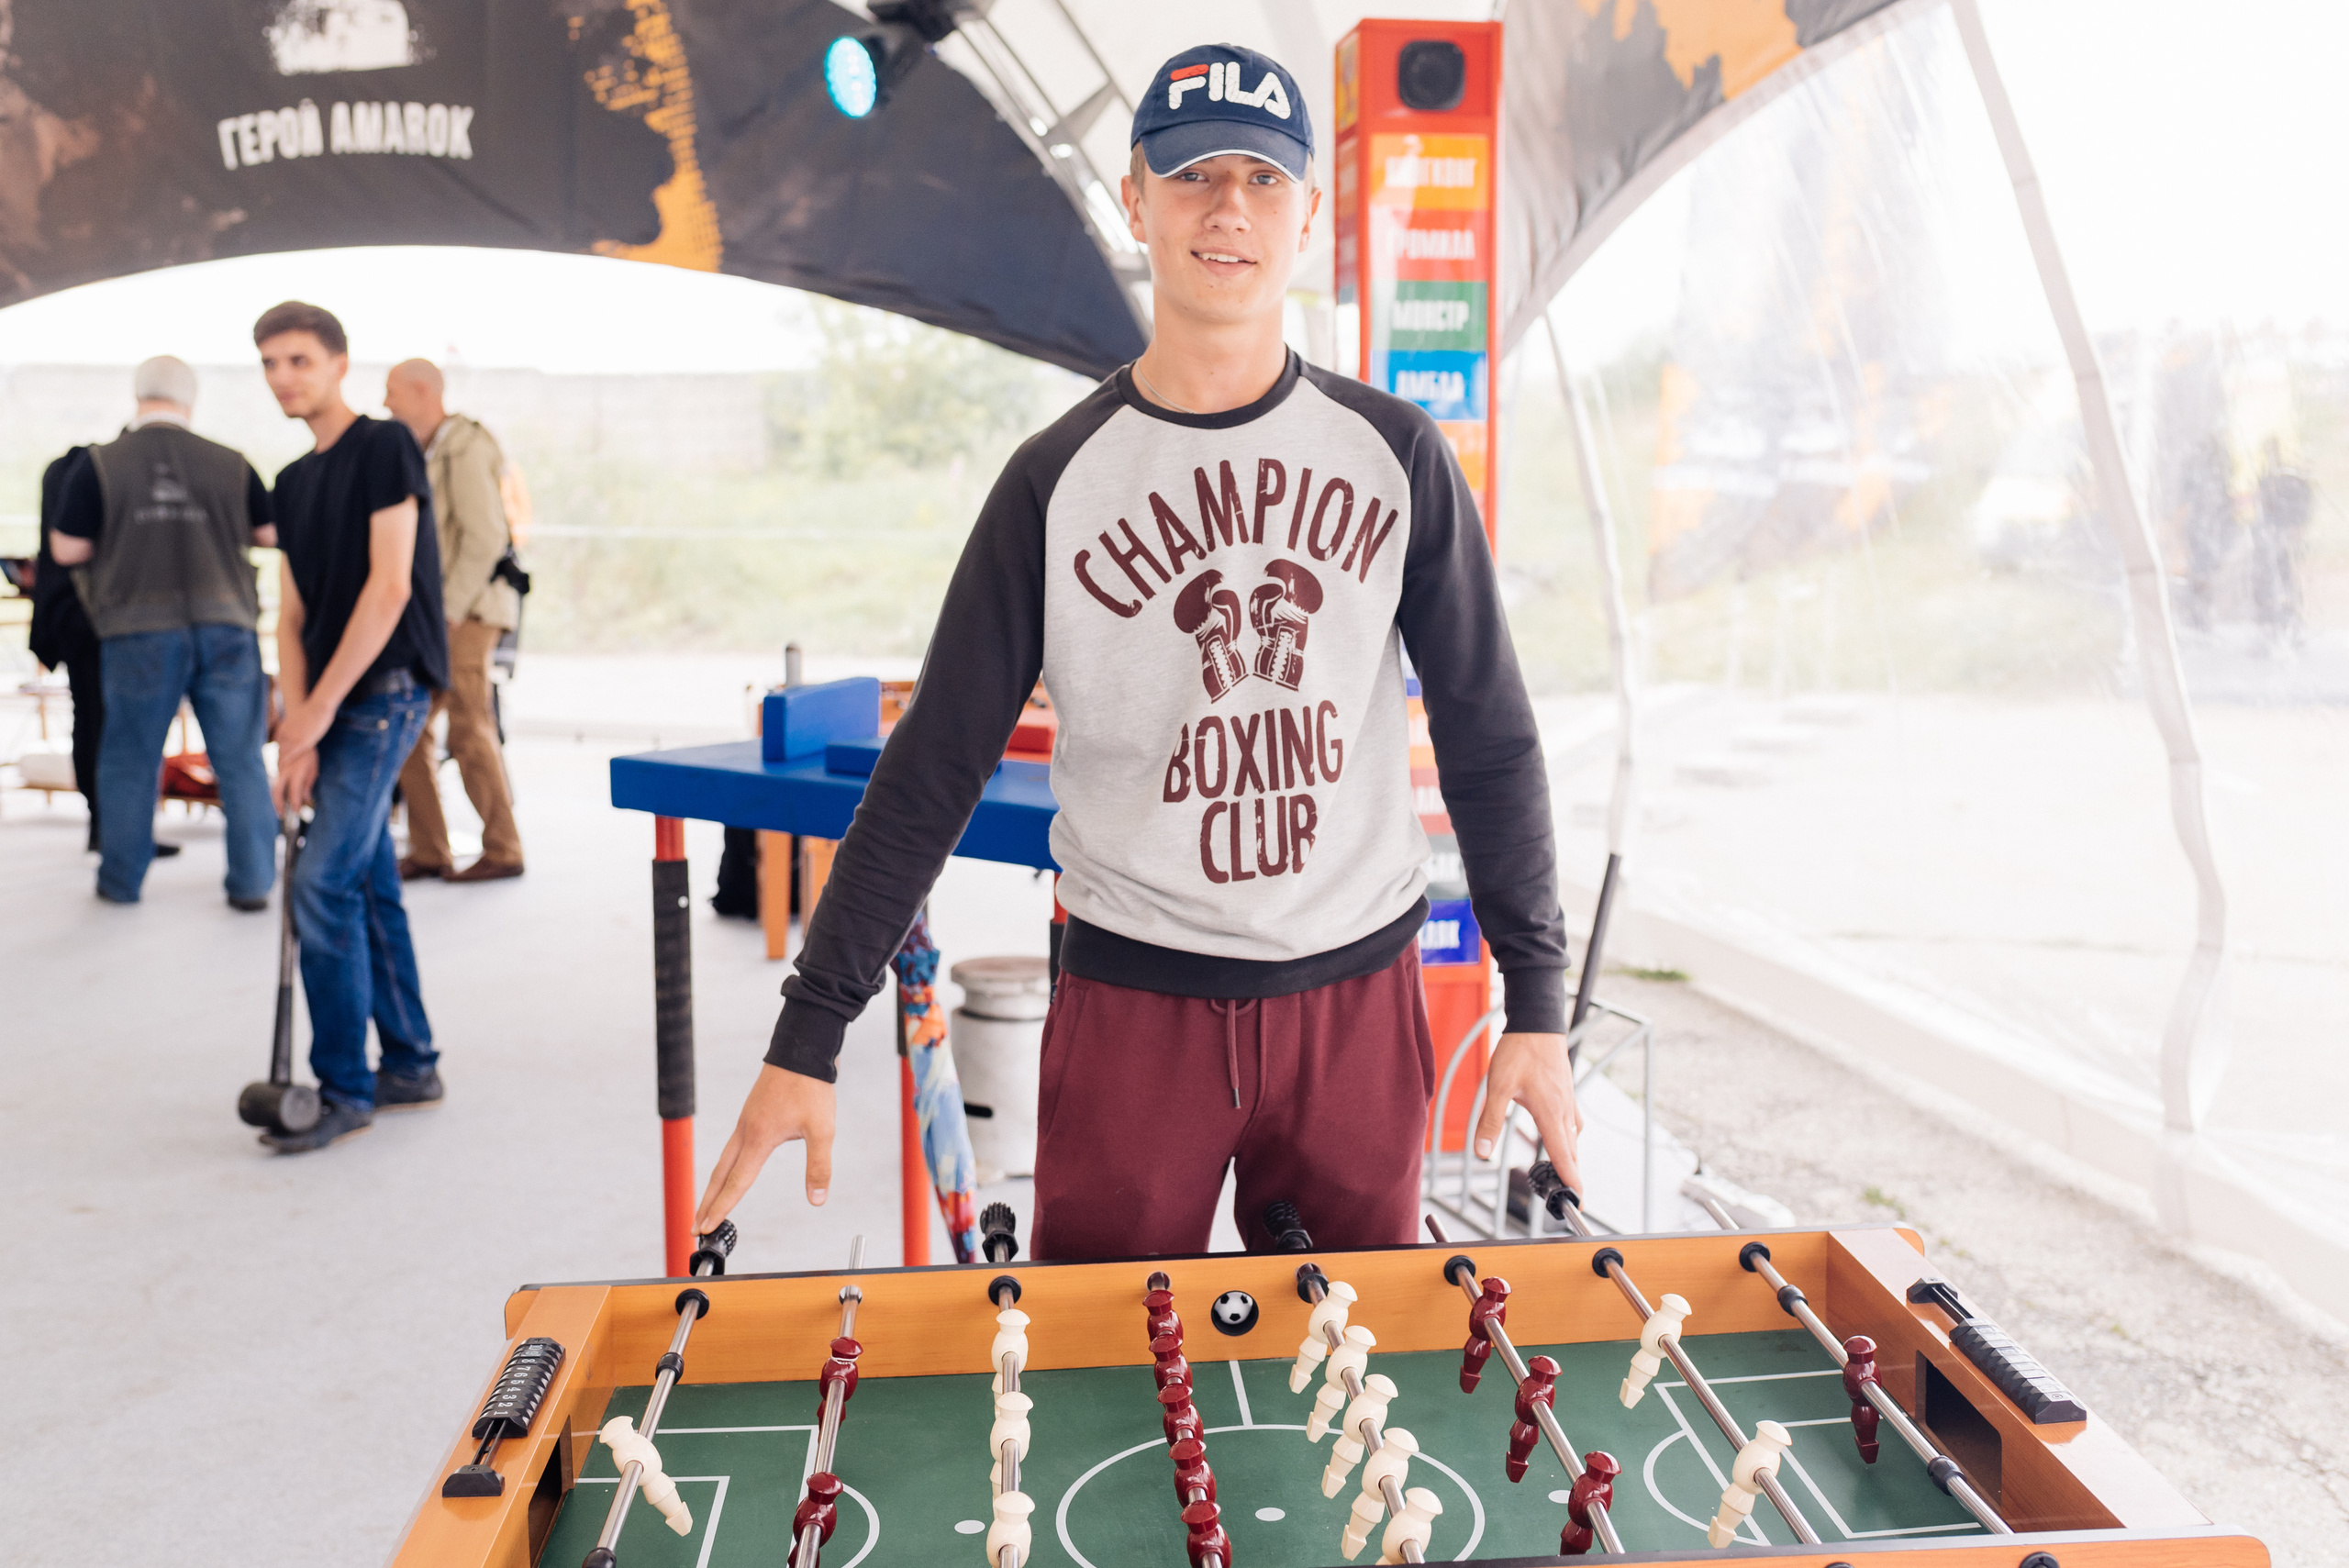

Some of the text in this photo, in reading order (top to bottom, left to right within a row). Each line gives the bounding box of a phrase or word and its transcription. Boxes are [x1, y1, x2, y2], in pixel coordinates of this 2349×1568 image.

[217, 97, 324, 171] ГЕРОЙ
[1168, 61, 1291, 120] FILA
[1074, 458, 1399, 618] CHAMPION
[1163, 699, 1343, 803] BOXING
[1199, 794, 1319, 884] CLUB
